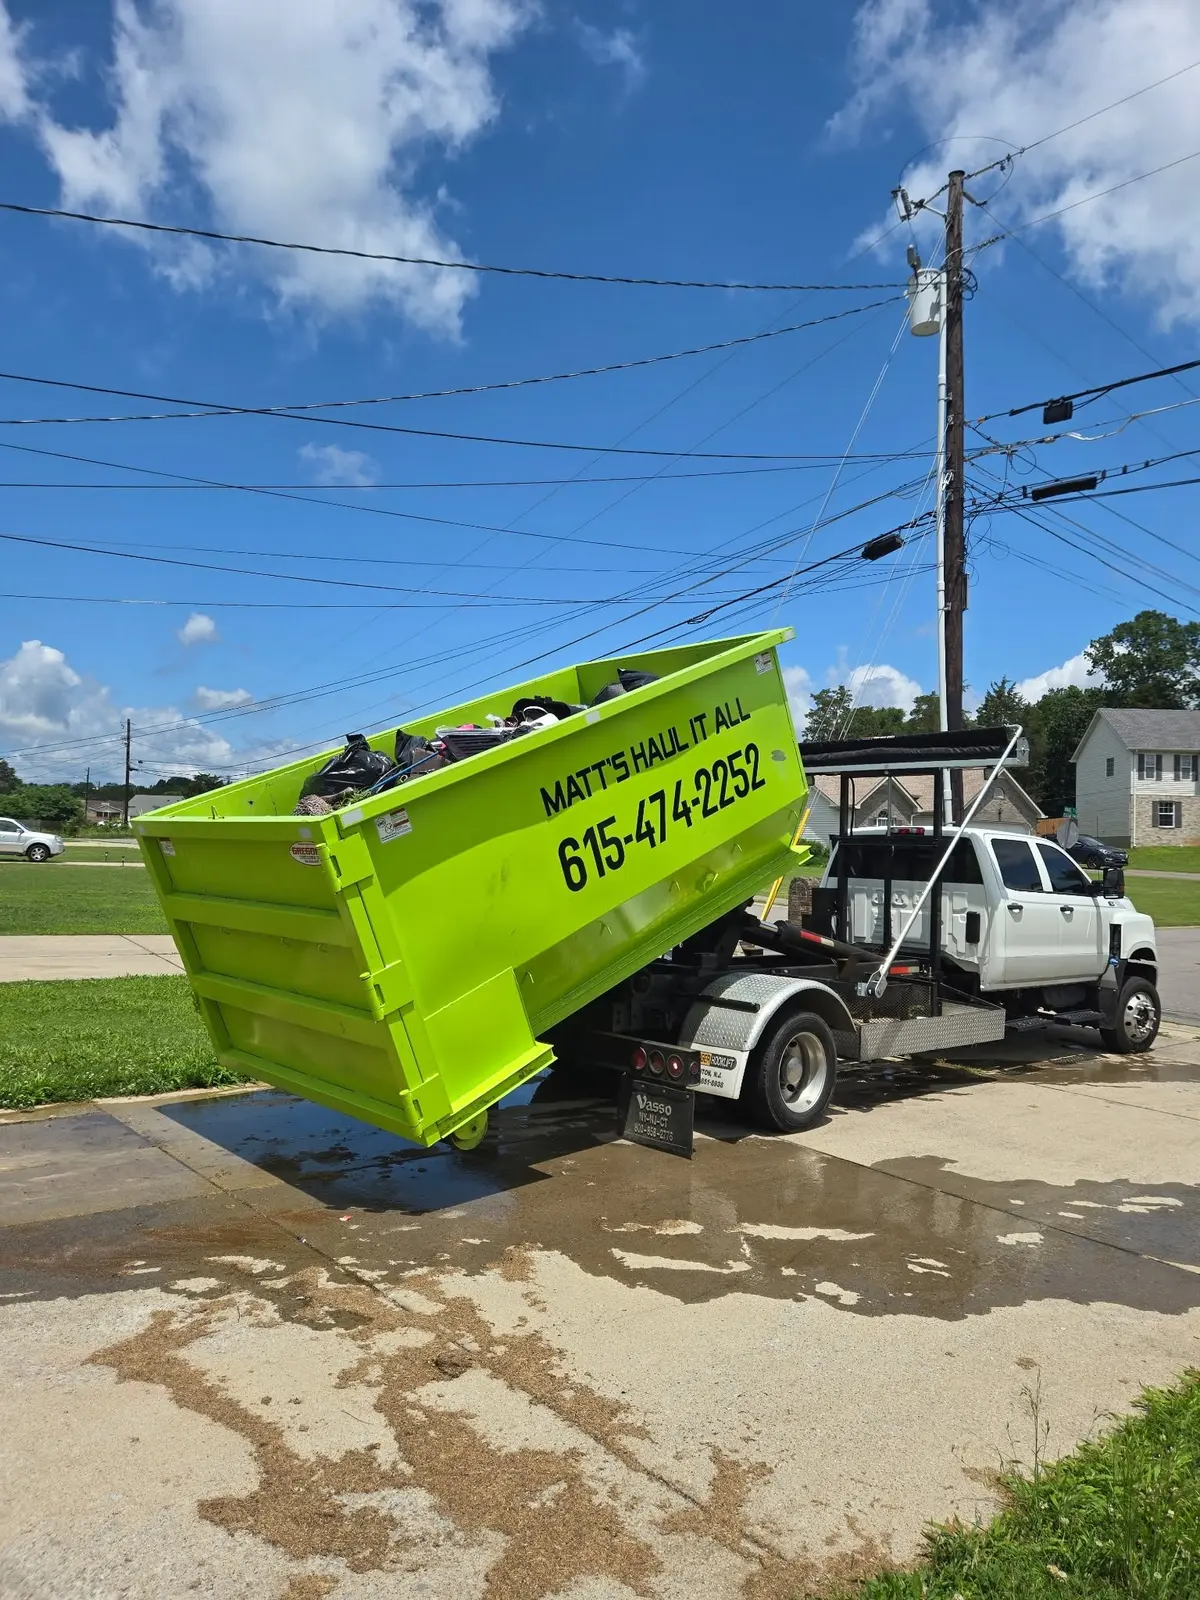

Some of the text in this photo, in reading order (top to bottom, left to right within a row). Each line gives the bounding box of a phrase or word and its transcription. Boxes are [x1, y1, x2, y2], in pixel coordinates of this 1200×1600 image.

[540, 697, 751, 817] MATT'S HAUL IT ALL
[558, 742, 766, 892] 615-474-2252
[636, 1094, 672, 1116] Vasso
[639, 1111, 668, 1128] NY-NJ-CT
